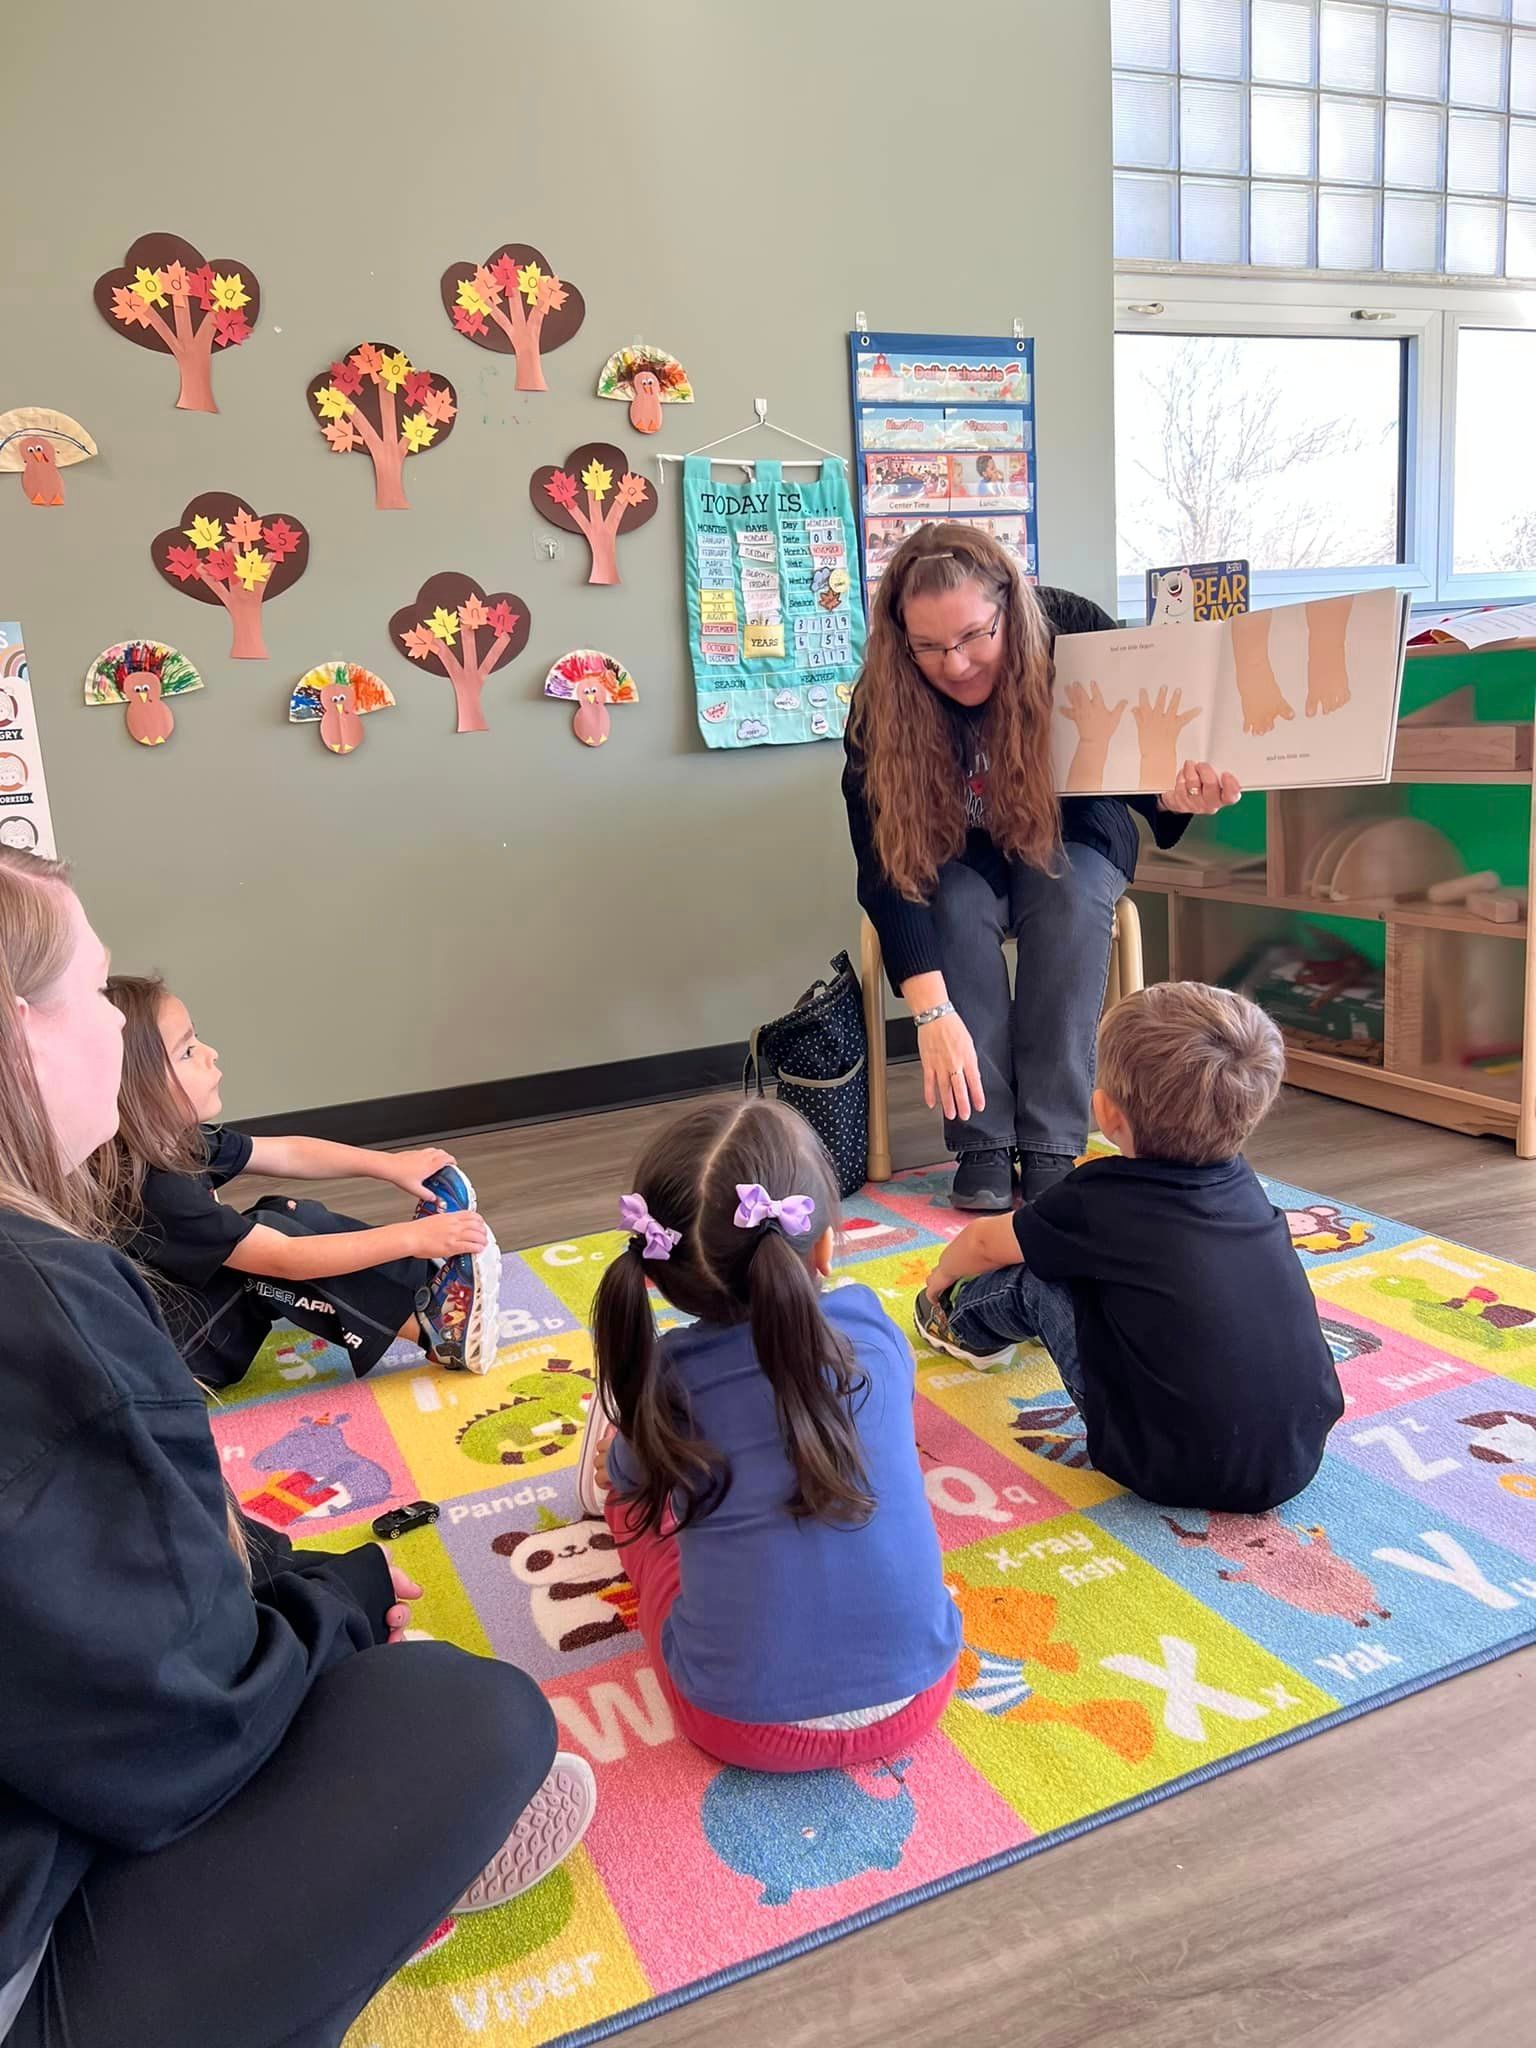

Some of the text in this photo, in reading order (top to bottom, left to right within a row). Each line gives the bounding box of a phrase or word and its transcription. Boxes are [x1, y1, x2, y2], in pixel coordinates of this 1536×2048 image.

[913, 364, 1005, 382] Daily Schedule
[885, 418, 924, 431] Morning
[700, 493, 769, 516] TODAY
[889, 502, 912, 510] Center
[697, 523, 728, 534] MONTHS
[745, 524, 769, 533] DAYS
[782, 519, 836, 531] Day WEDNESDAY
[702, 536, 726, 544] JANUARY
[782, 535, 800, 544] Date
[702, 549, 728, 557] FEBRUARY
[745, 547, 770, 560] TUESDAY
[783, 548, 808, 556] Month
[785, 556, 837, 568] Year 2023
[708, 568, 724, 577] APRIL
[712, 579, 724, 587] MAY
[749, 579, 770, 588] FRIDAY
[711, 592, 725, 600] JUNE
[1193, 574, 1247, 607] BEAR
[788, 599, 815, 608] Season
[706, 612, 729, 620] AUGUST
[704, 625, 734, 633] SEPTEMBER
[706, 643, 732, 652] OCTOBER
[750, 638, 779, 647] YEARS
[708, 654, 735, 663] DECEMBER
[714, 680, 747, 689] SEASON
[543, 1244, 585, 1267] C
[1397, 1244, 1484, 1280] T
[498, 1308, 566, 1339] B b
[1376, 1361, 1463, 1392] Skunk
[1350, 1425, 1463, 1482] Z
[924, 1465, 1014, 1523] Q
[449, 1484, 557, 1524] Panda
[984, 1529, 1094, 1573] X-ray
[1059, 1554, 1127, 1588] fish
[1370, 1530, 1520, 1610] Y
[1312, 1641, 1401, 1680] Yak
[1100, 1634, 1302, 1743] X x
[548, 1667, 676, 1764] W
[452, 1951, 600, 2033] Viper
